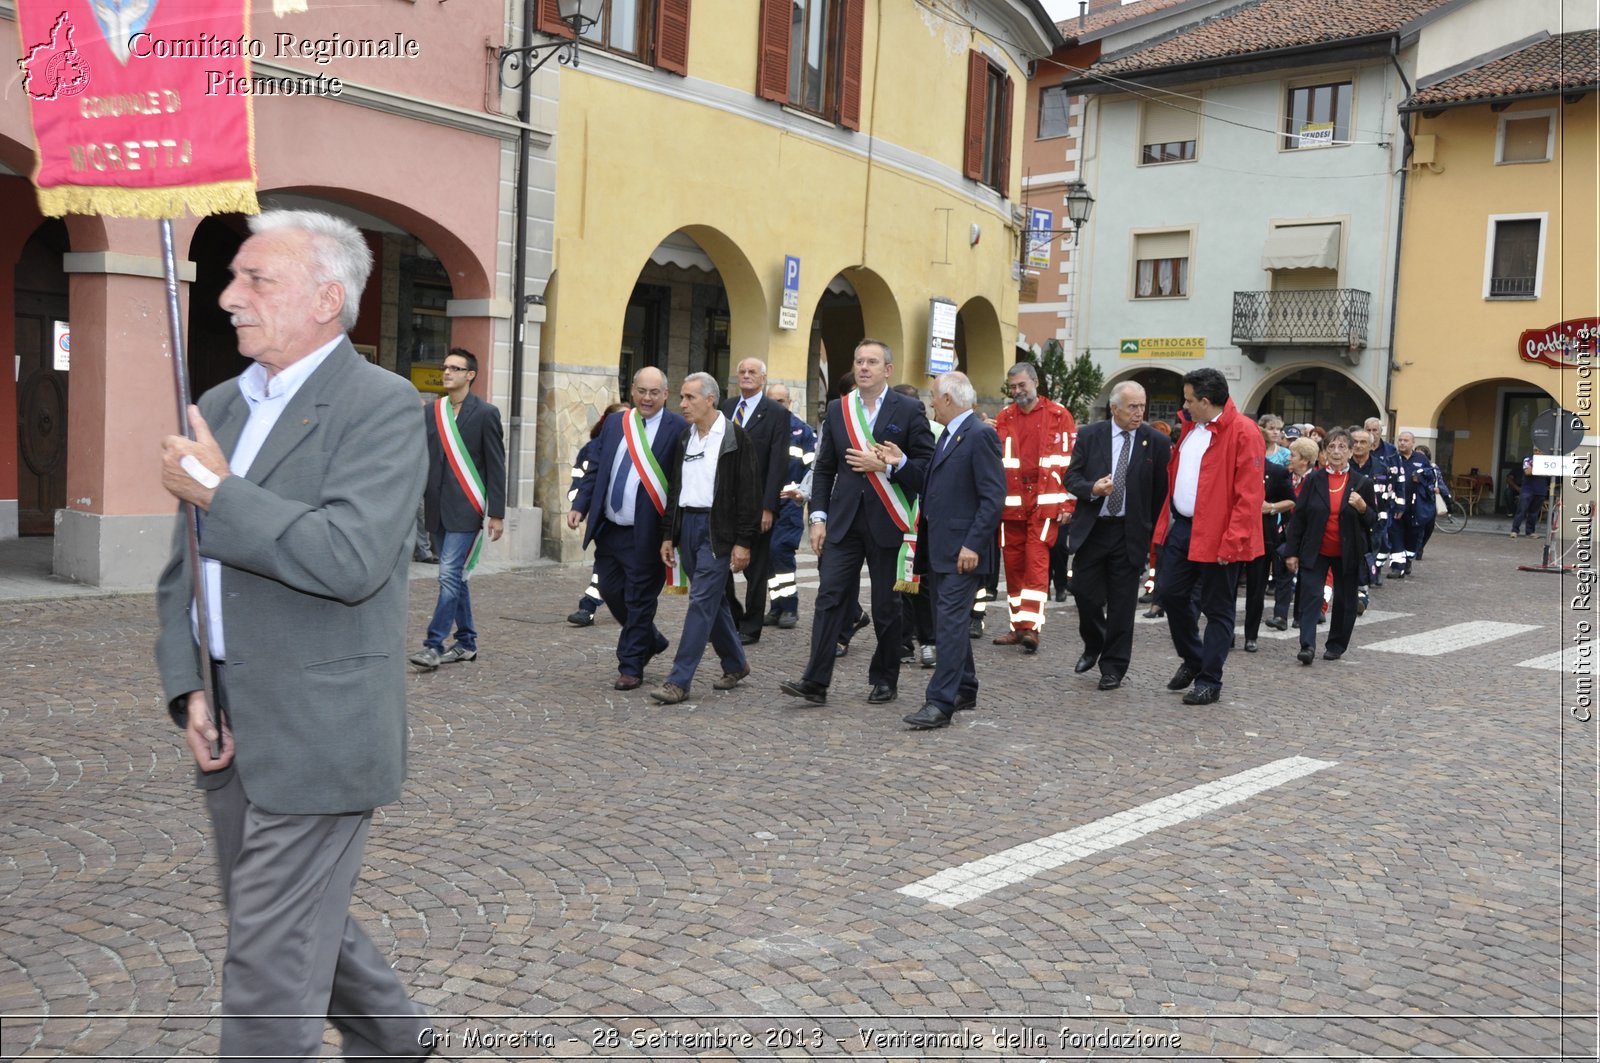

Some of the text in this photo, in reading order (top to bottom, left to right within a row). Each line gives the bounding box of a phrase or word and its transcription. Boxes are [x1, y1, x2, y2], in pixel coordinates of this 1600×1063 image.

[1301, 130, 1331, 139] VENDESI
[69, 139, 193, 172] MORETTA
[787, 259, 798, 286] P
[1140, 337, 1205, 348] CENTROCASE
[1150, 350, 1194, 358] Immobiliare
[1543, 461, 1557, 469] 50
